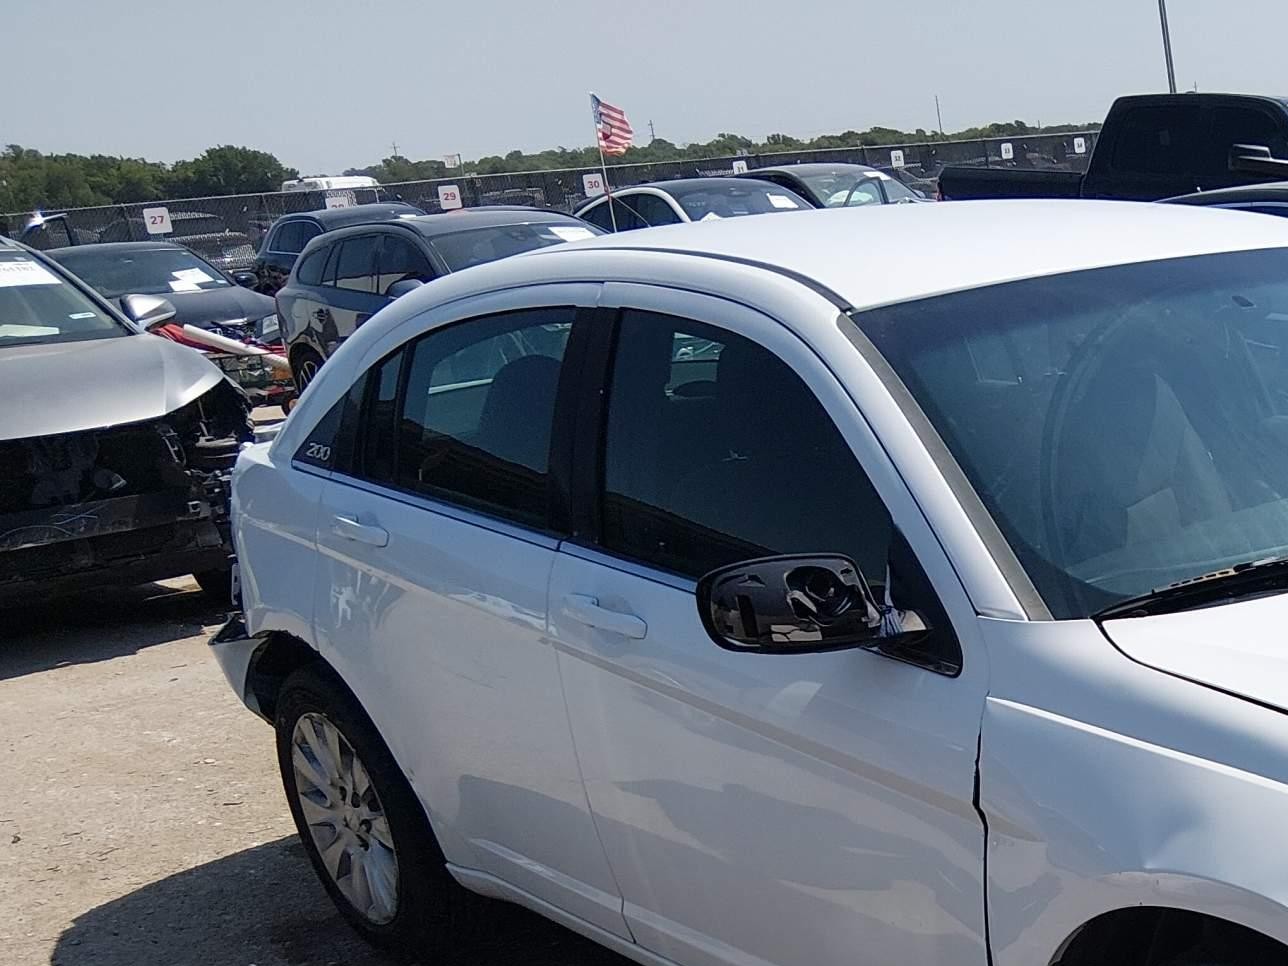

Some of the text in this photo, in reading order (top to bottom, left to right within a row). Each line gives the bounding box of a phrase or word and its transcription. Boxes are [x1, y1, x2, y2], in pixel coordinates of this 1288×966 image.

[587, 180, 600, 189] 30
[443, 192, 456, 201] 29
[150, 215, 164, 225] 27
[306, 442, 331, 461] 200
